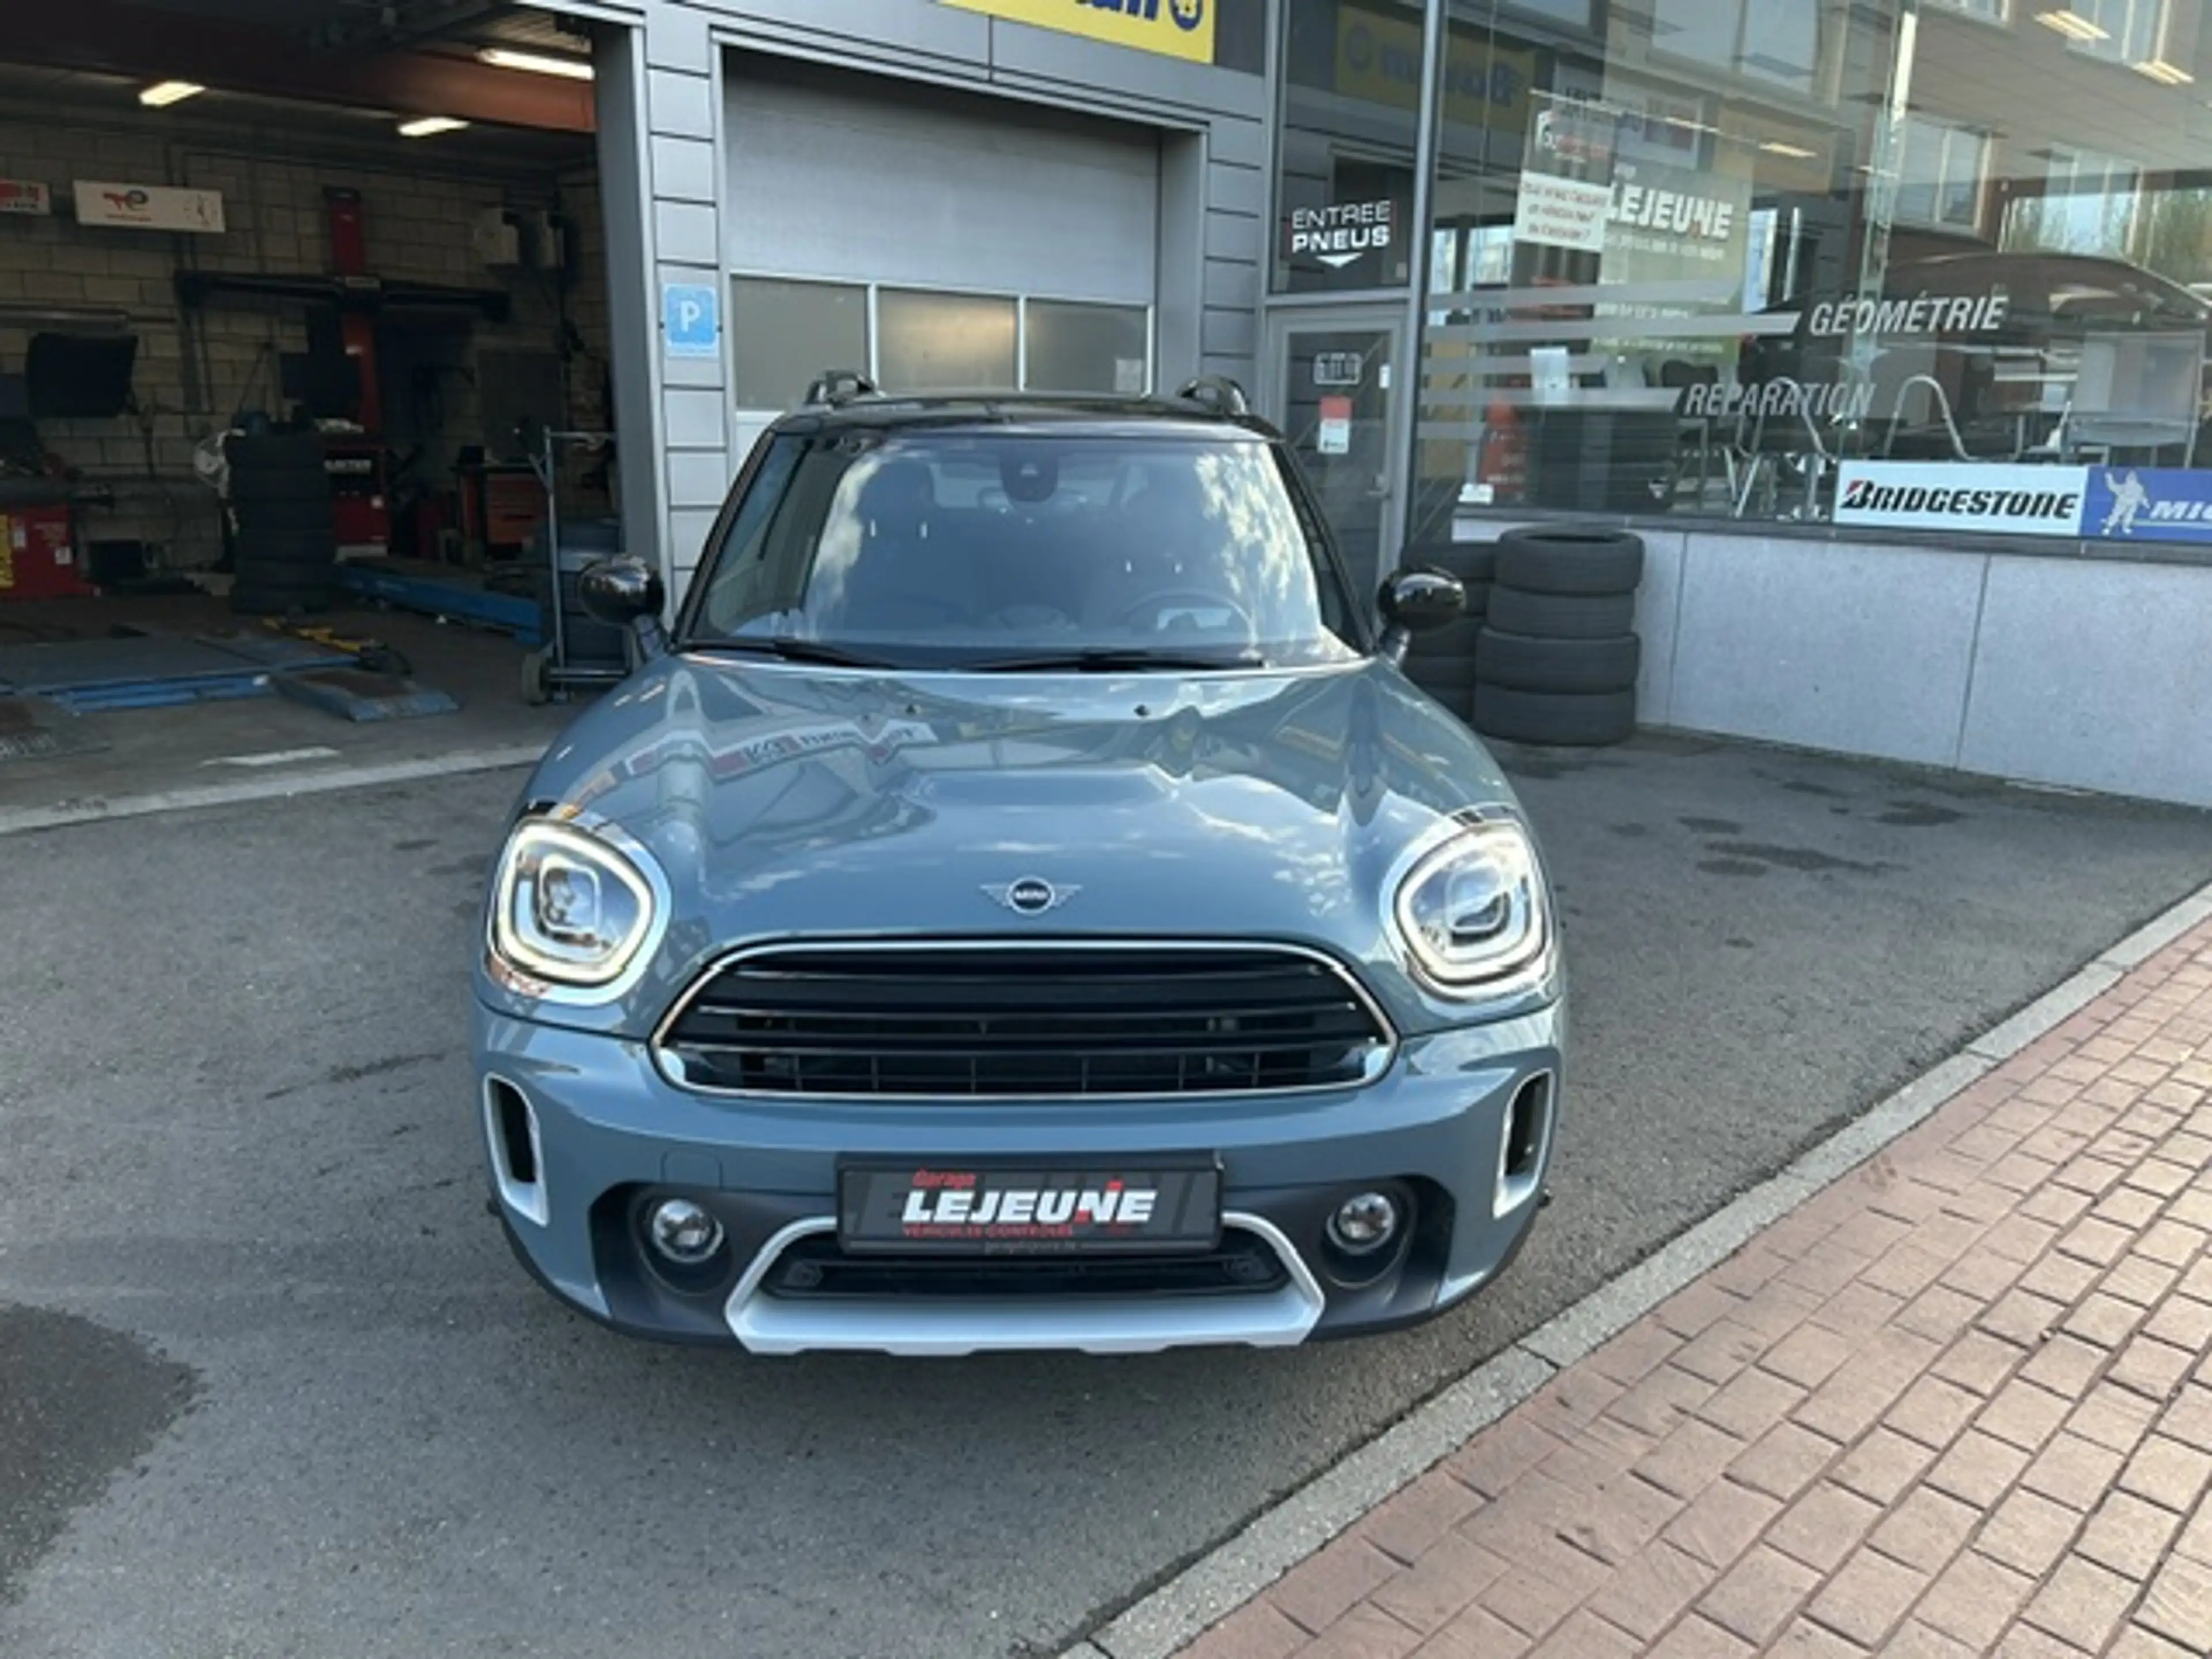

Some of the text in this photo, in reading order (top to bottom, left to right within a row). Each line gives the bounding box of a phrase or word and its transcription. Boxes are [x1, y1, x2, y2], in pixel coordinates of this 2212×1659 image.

[1292, 225, 1391, 253] PNEUS
[680, 300, 700, 332] P
[1809, 291, 2009, 336] GÉOMÉTRIE
[1840, 480, 2080, 519] BRIDGESTONE
[902, 1180, 1157, 1224] LEJEUNE
